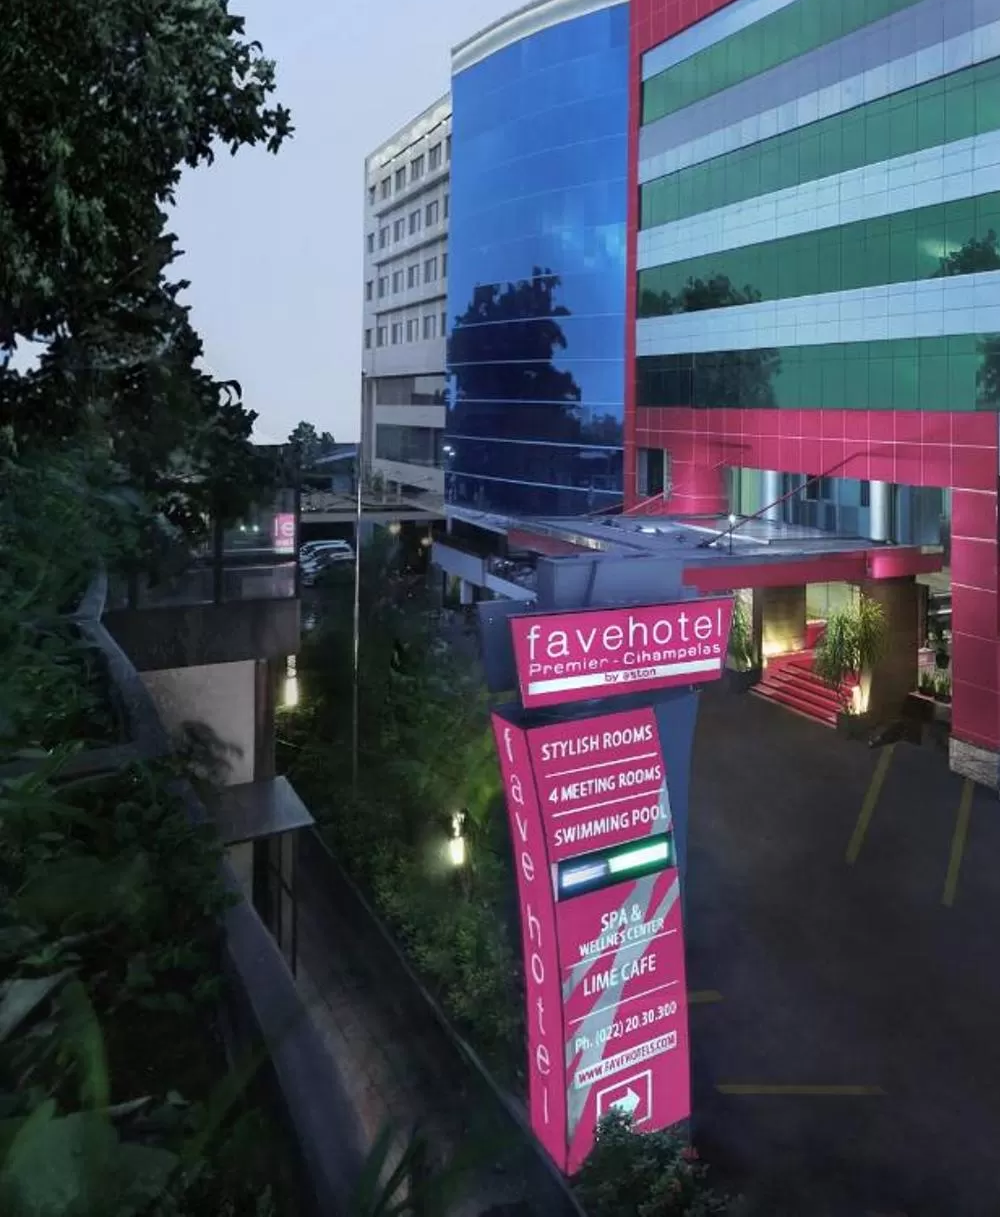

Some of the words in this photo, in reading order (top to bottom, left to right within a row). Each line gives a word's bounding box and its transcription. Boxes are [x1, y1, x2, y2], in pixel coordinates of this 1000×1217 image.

[526, 607, 722, 660] favehotel
[529, 657, 608, 676] Premier
[623, 643, 721, 665] Cihampelas
[604, 672, 619, 682] by
[622, 668, 657, 679] aston
[541, 734, 600, 761] STYLISH
[602, 724, 653, 748] ROOMS
[549, 788, 558, 804] 4
[560, 776, 616, 802] MEETING
[618, 765, 661, 788] ROOMS
[554, 812, 630, 847] SWIMMING
[632, 804, 667, 826] POOL
[601, 907, 628, 932] SPA
[630, 903, 642, 922] &
[626, 918, 664, 941] CENTER
[583, 968, 618, 996] LIME
[621, 953, 657, 981] CAFE
[575, 1034, 593, 1054] Ph.
[595, 1019, 624, 1046] (022)
[625, 1000, 677, 1033] 20.30.300
